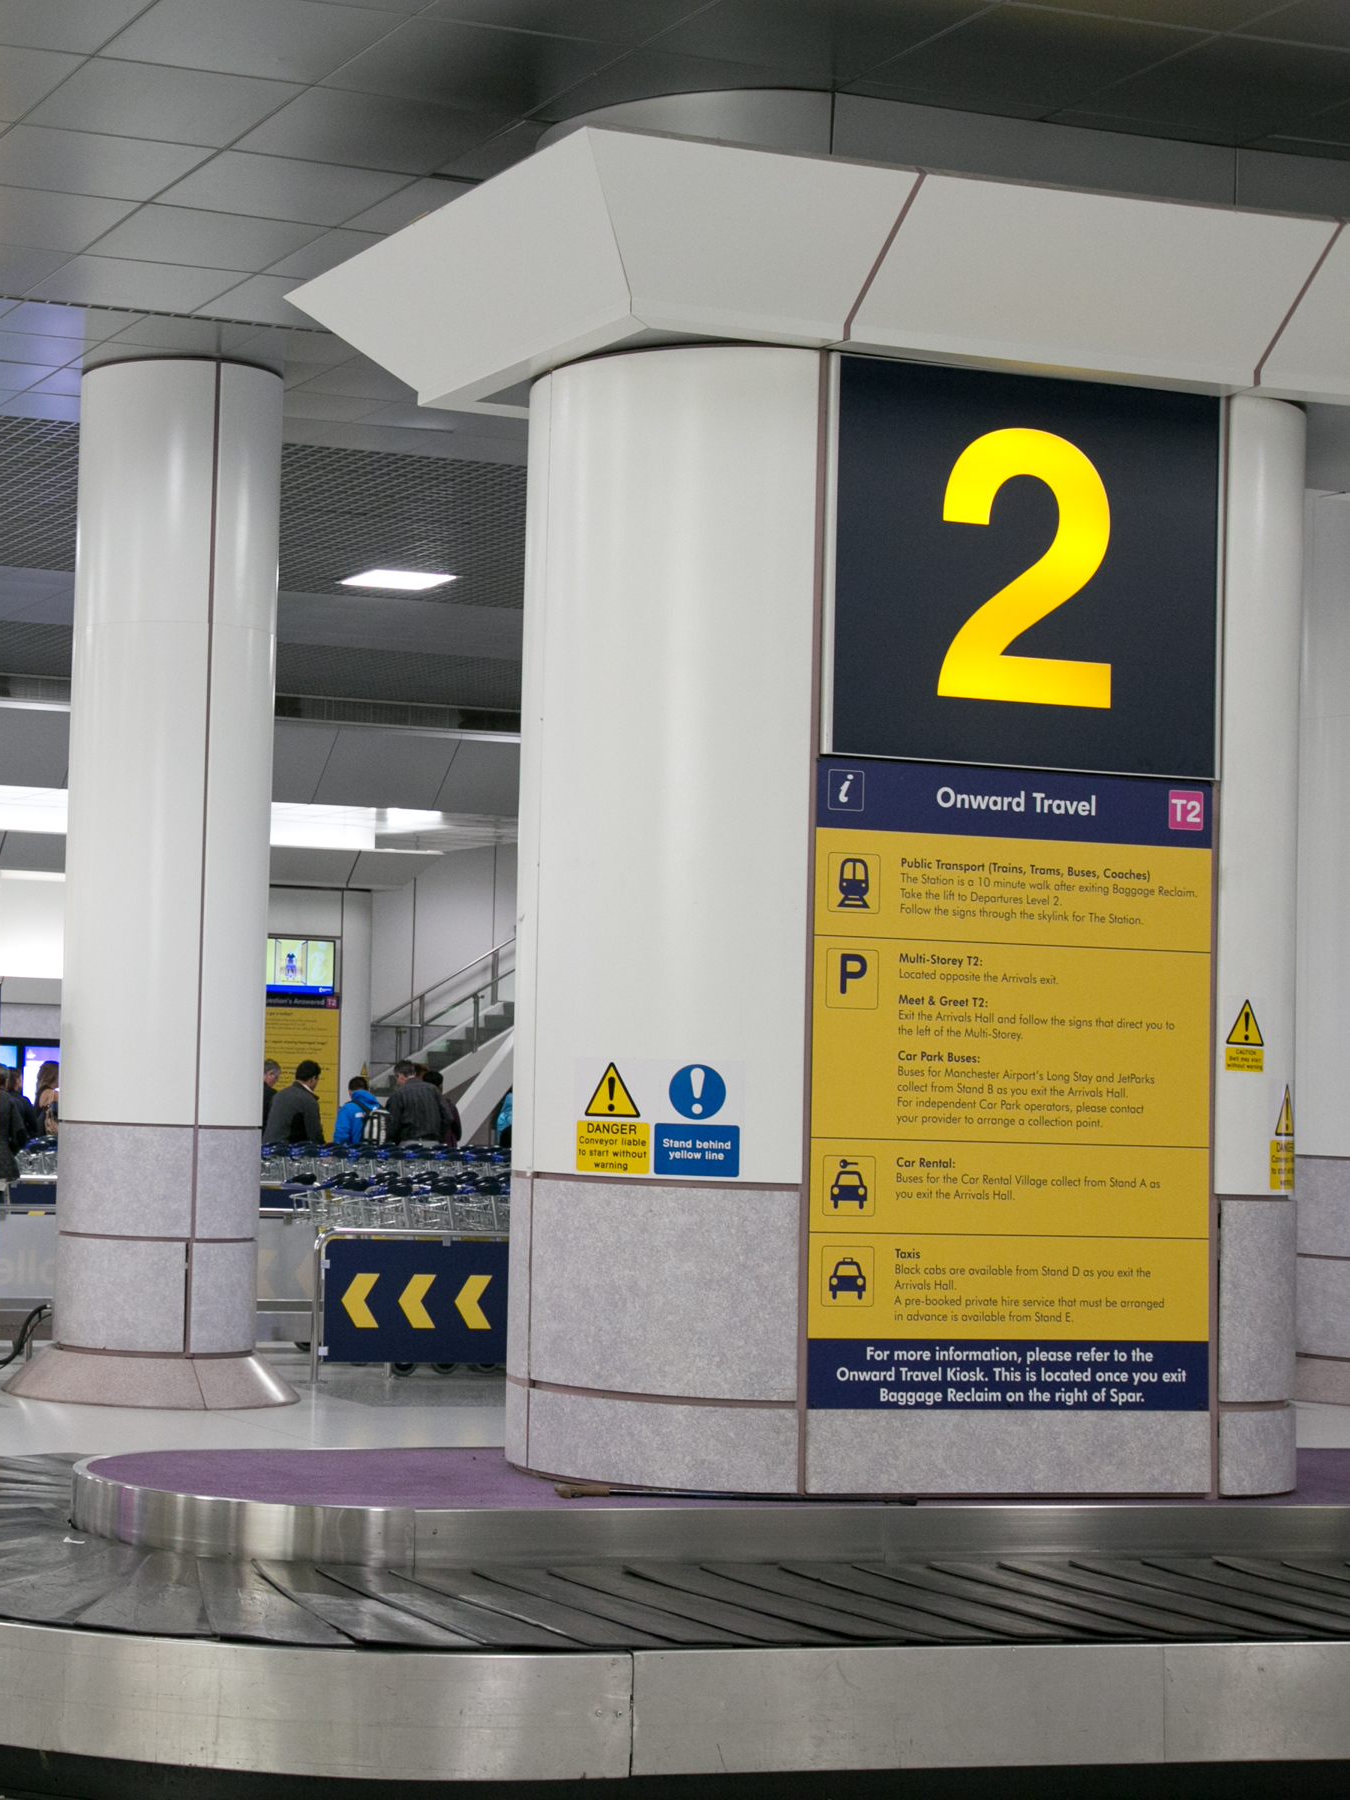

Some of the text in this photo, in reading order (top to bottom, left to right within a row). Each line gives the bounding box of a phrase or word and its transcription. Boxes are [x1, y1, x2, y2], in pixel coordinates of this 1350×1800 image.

[938, 427, 1112, 709] 2
[937, 787, 1025, 812] Onward
[1032, 793, 1096, 816] Travel
[1172, 799, 1201, 823] T2
[902, 858, 1150, 883] Public Transport (Trains, Trams, Buses, Coaches)
[902, 873, 918, 884] The
[922, 874, 954, 885] Station
[958, 876, 964, 886] is
[979, 877, 990, 887] 10
[994, 878, 1026, 889] minute
[1029, 880, 1051, 890] walk
[1054, 880, 1076, 892] after
[1079, 882, 1109, 896] exiting
[1113, 884, 1155, 898] Baggage
[1158, 886, 1198, 898] Reclaim.
[900, 953, 982, 968] Multi-Storey T2:
[900, 968, 1058, 985] Located opposite the Arrivals exit.
[899, 994, 988, 1008] Meet & Greet T2:
[898, 1050, 980, 1063] Car Park Buses:
[587, 1123, 636, 1135] DANGER
[579, 1136, 646, 1146] Conveyor liable
[663, 1139, 731, 1150] Stand behind
[579, 1148, 586, 1156] to
[612, 1150, 647, 1158] without
[669, 1150, 724, 1160] yellow line
[594, 1162, 628, 1171] warning
[897, 1157, 955, 1168] Car Rental:
[895, 1248, 920, 1259] Taxis
[894, 1295, 1164, 1310] A pre-booked private hire service that must be arranged
[867, 1346, 1153, 1364] For more information, please refer to the
[837, 1367, 1186, 1385] Onward Travel Kiosk. This is located once you exit
[880, 1388, 1144, 1406] Baggage Reclaim on the right of Spar.
